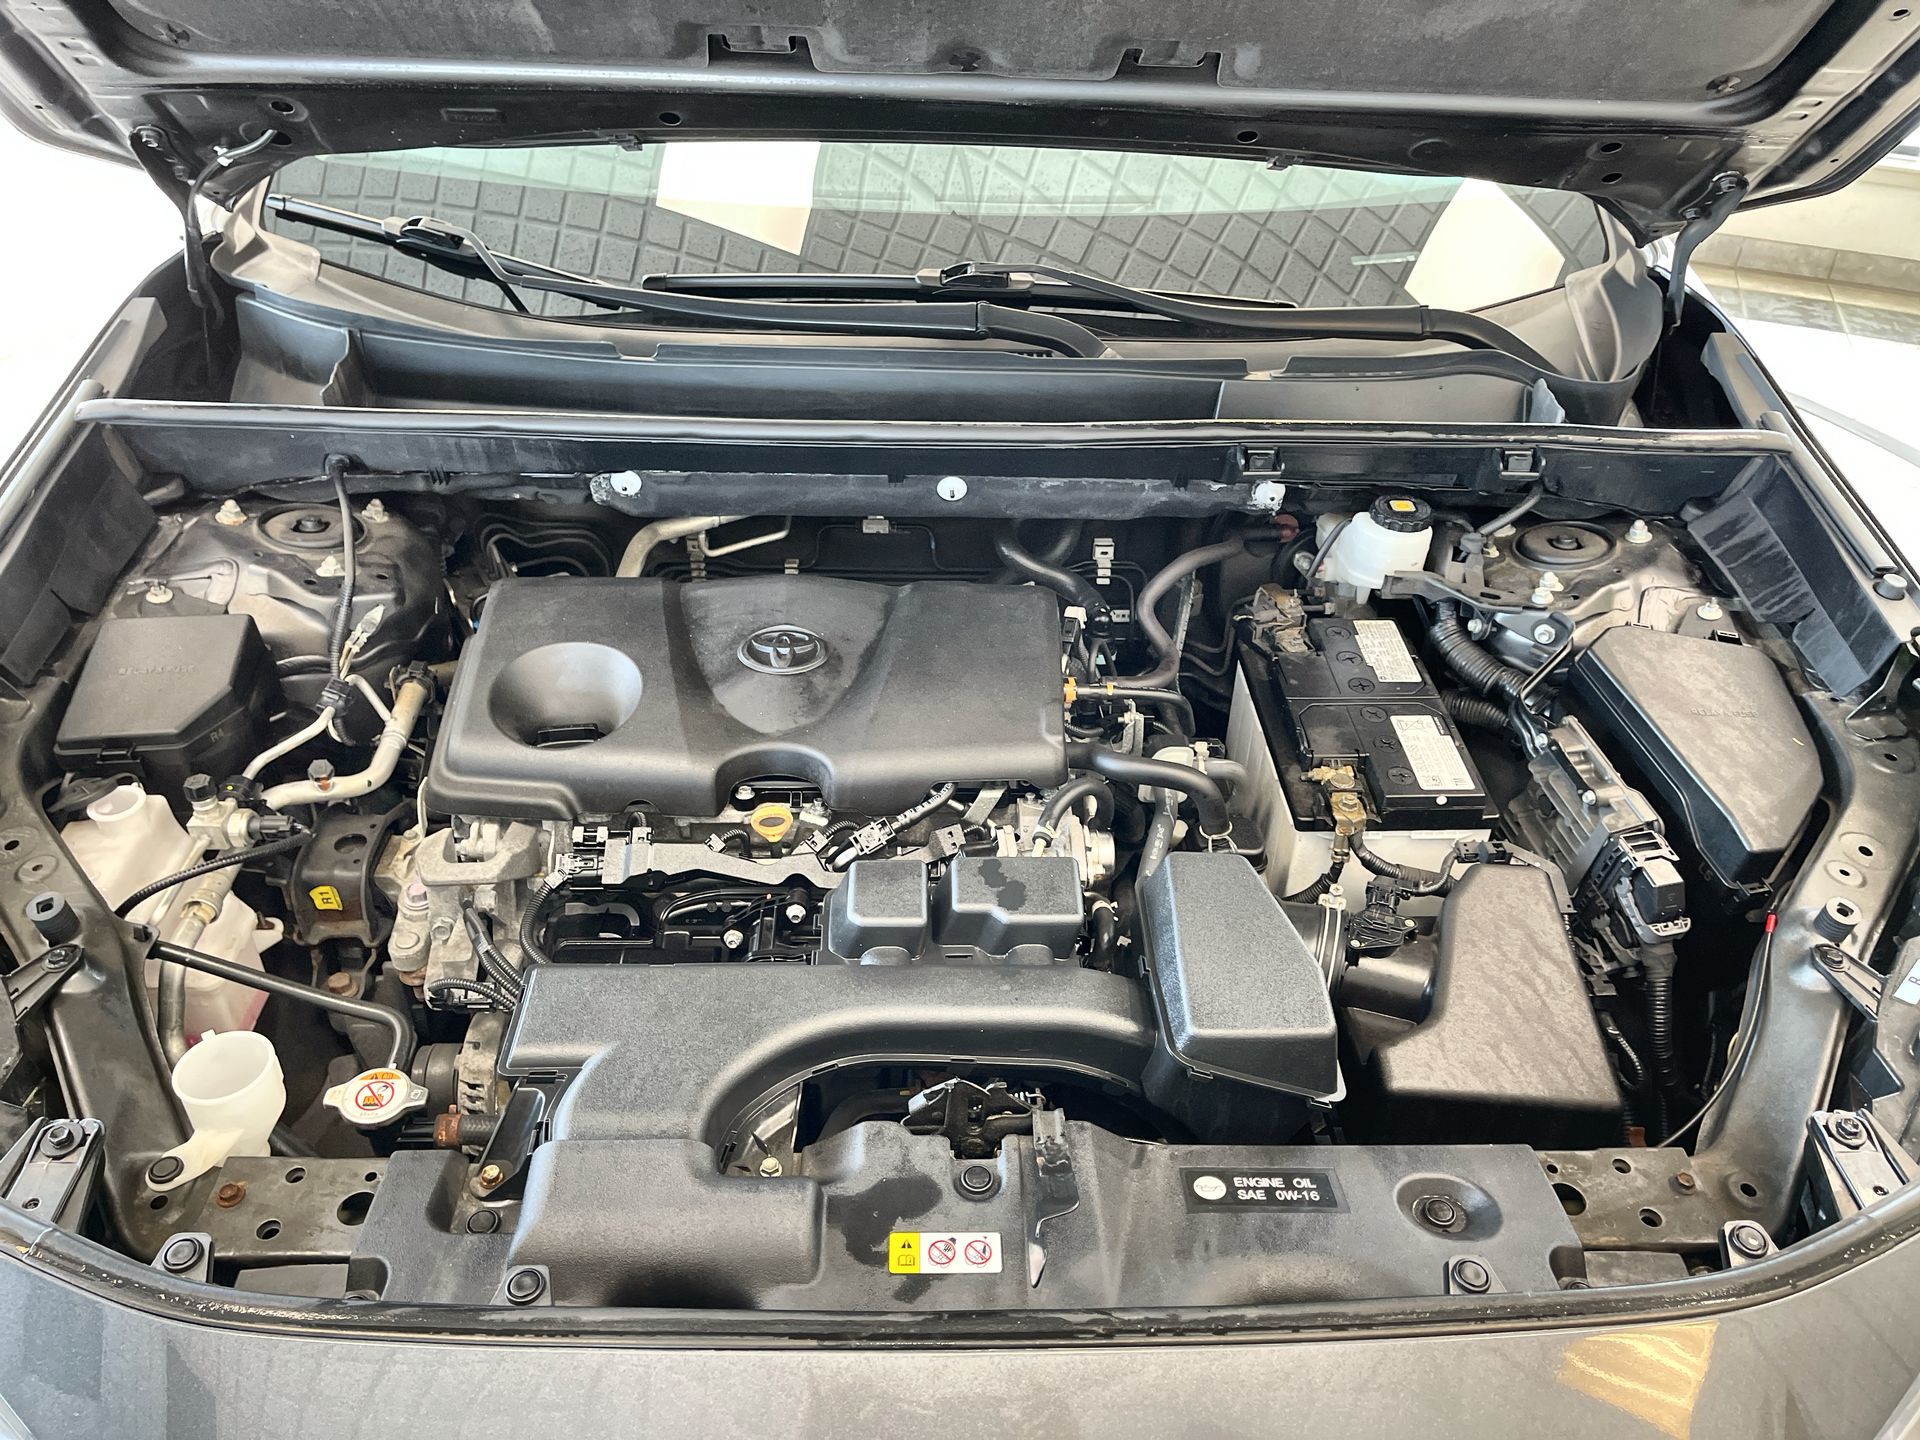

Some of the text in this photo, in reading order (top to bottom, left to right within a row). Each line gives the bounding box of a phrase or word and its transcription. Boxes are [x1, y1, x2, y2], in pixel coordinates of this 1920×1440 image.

[318, 891, 334, 905] R1
[1233, 1176, 1317, 1189] ENGINE OIL
[1237, 1189, 1320, 1202] SAE 0W-16
